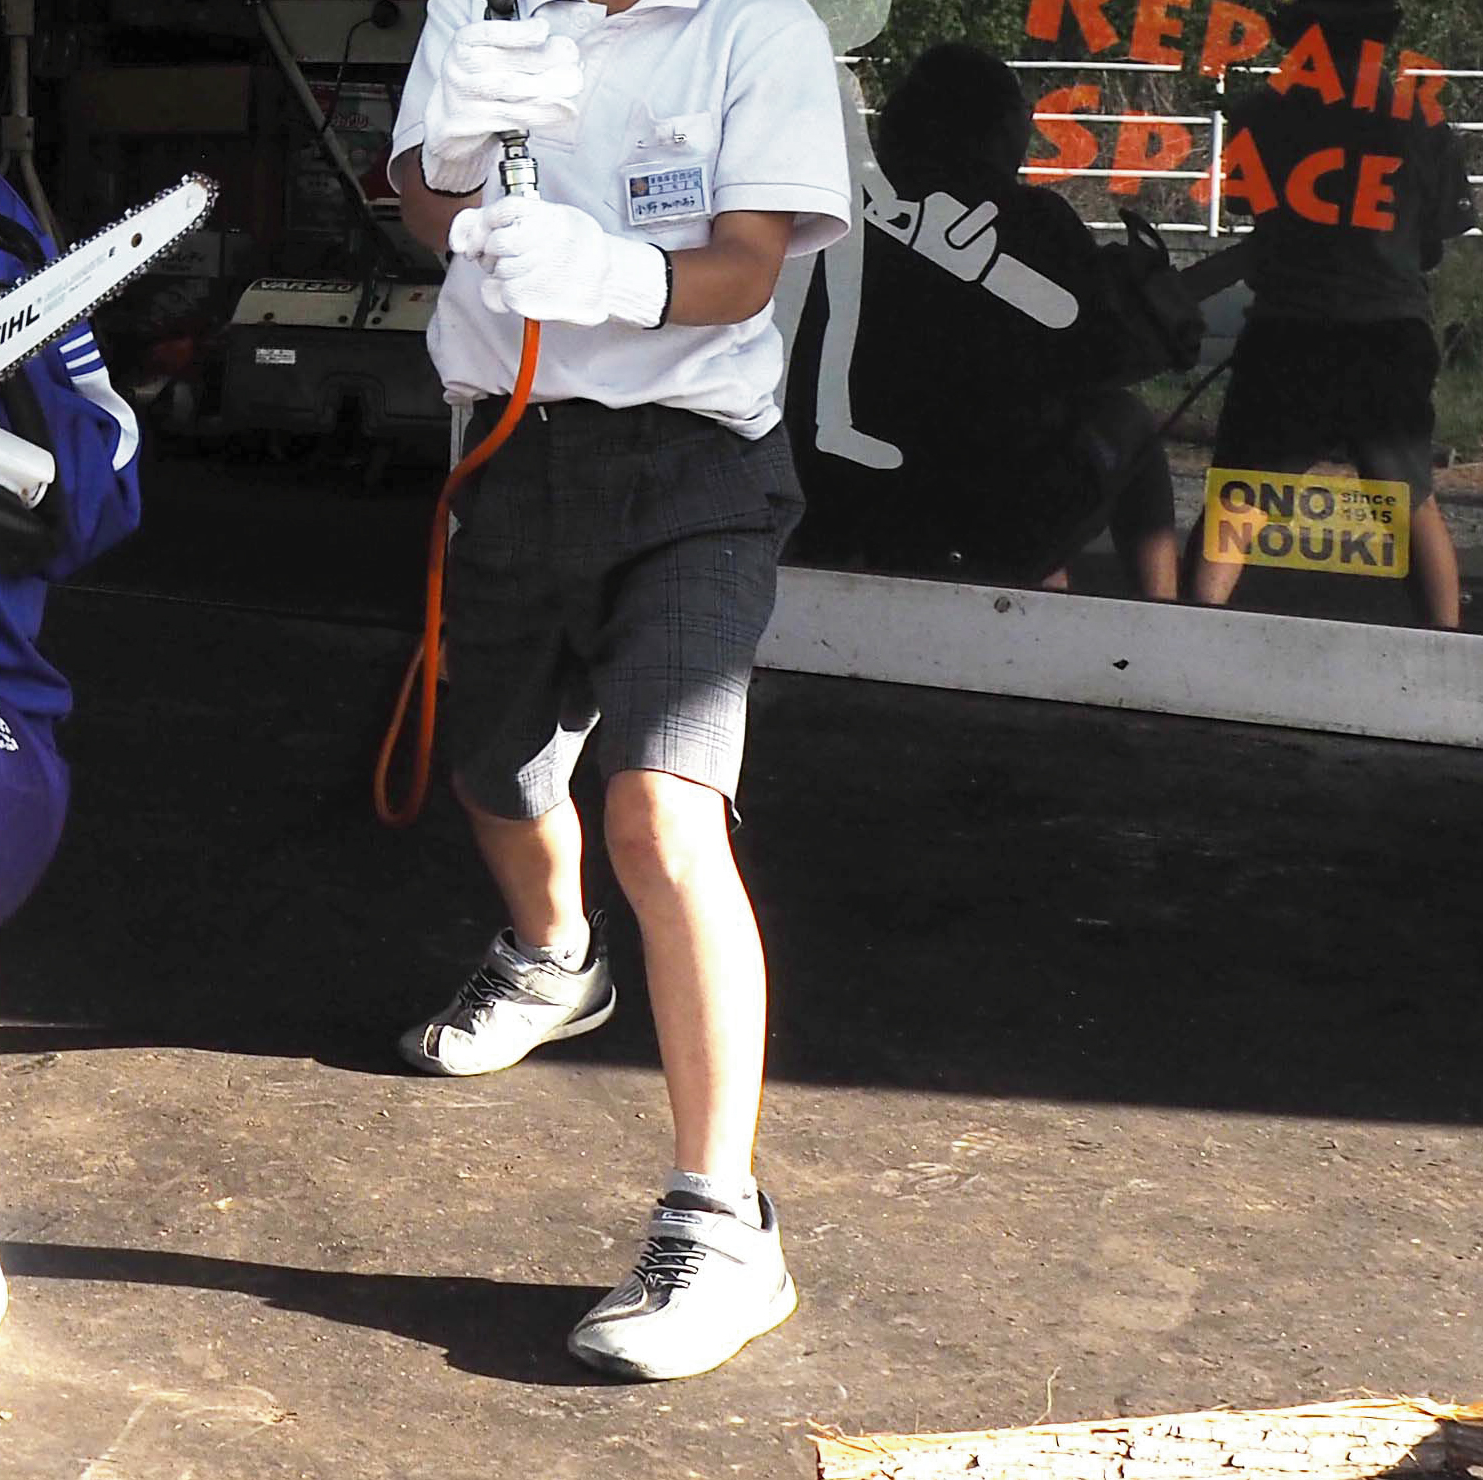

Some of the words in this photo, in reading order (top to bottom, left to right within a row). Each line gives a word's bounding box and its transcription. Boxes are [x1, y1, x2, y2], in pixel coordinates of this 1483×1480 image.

[1026, 84, 1403, 231] SPACE
[1219, 480, 1336, 520] ONO
[1341, 490, 1396, 505] since
[1342, 509, 1393, 524] 1915
[1218, 519, 1396, 567] NOUKI
